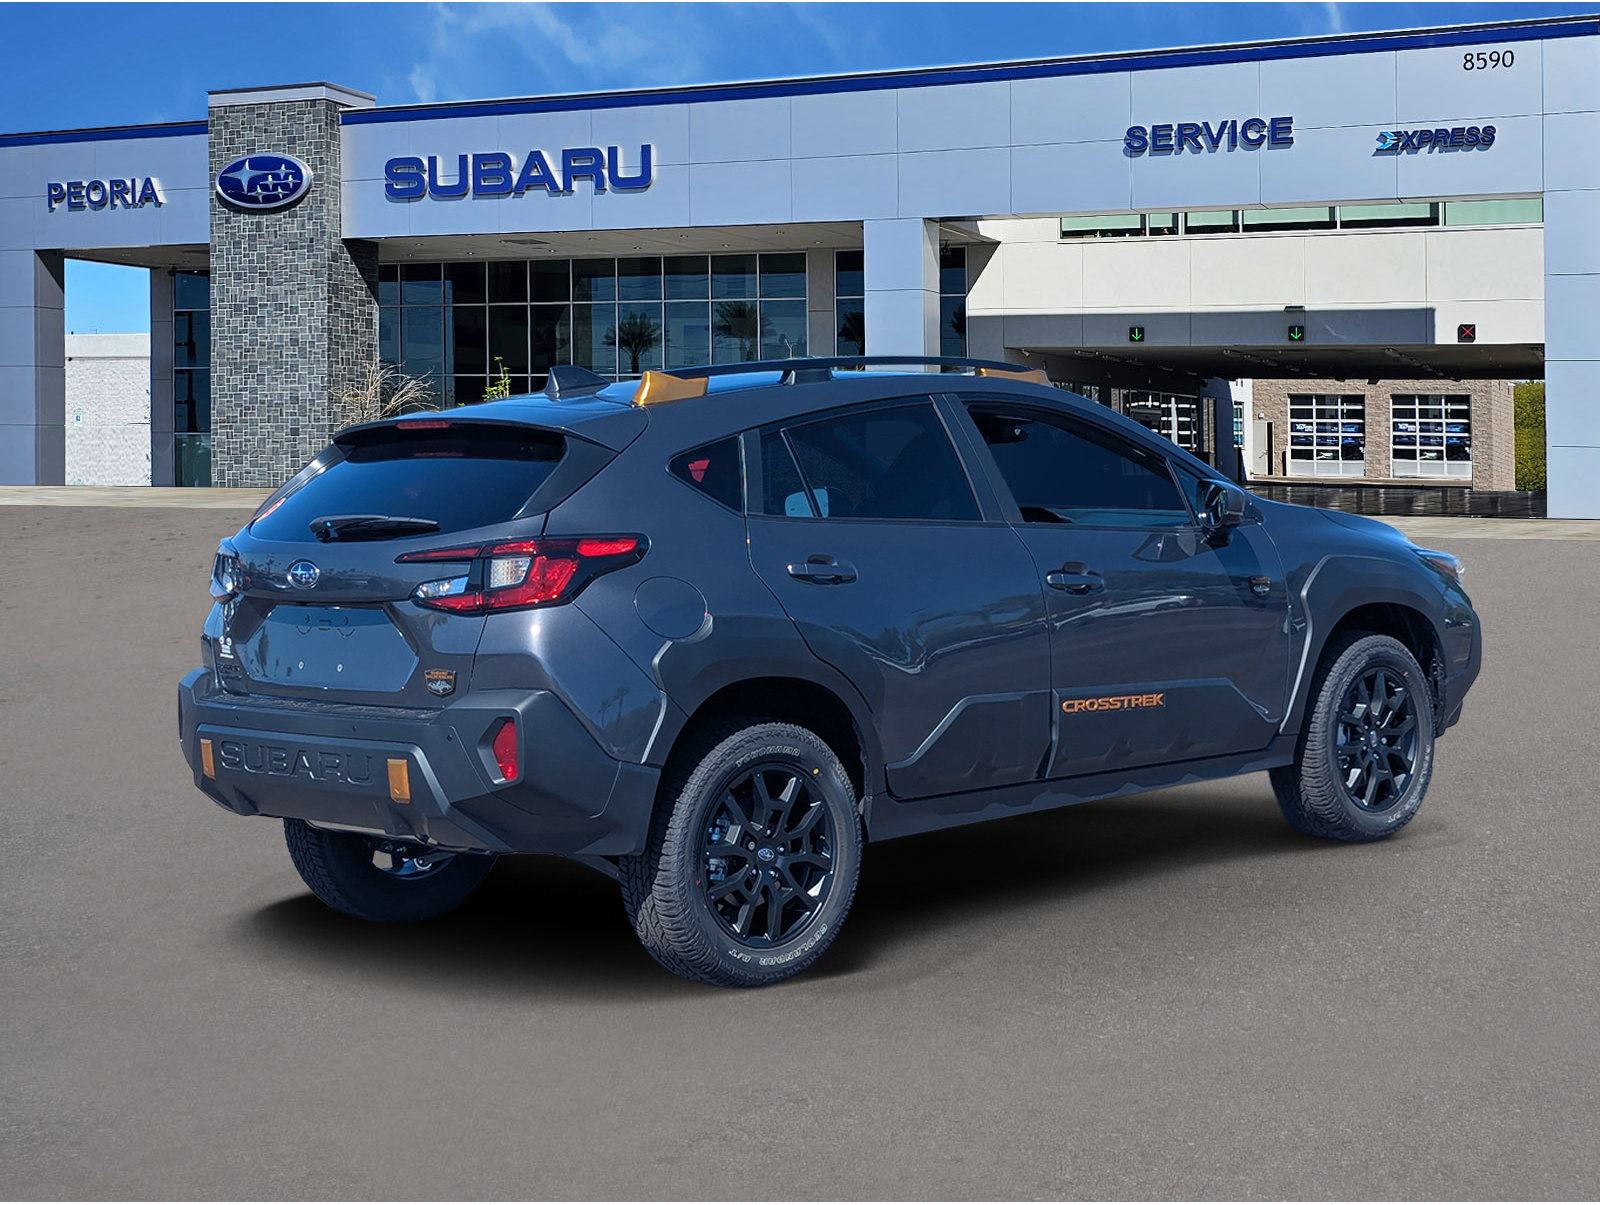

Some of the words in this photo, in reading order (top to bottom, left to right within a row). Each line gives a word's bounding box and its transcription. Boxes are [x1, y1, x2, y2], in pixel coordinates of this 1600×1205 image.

[1463, 50, 1514, 71] 8590
[1124, 116, 1294, 153] SERVICE
[1376, 125, 1497, 152] EXPRESS
[384, 144, 652, 200] SUBARU
[47, 176, 164, 211] PEORIA
[1062, 693, 1164, 713] CROSSTREK
[220, 740, 374, 786] SUBARU
